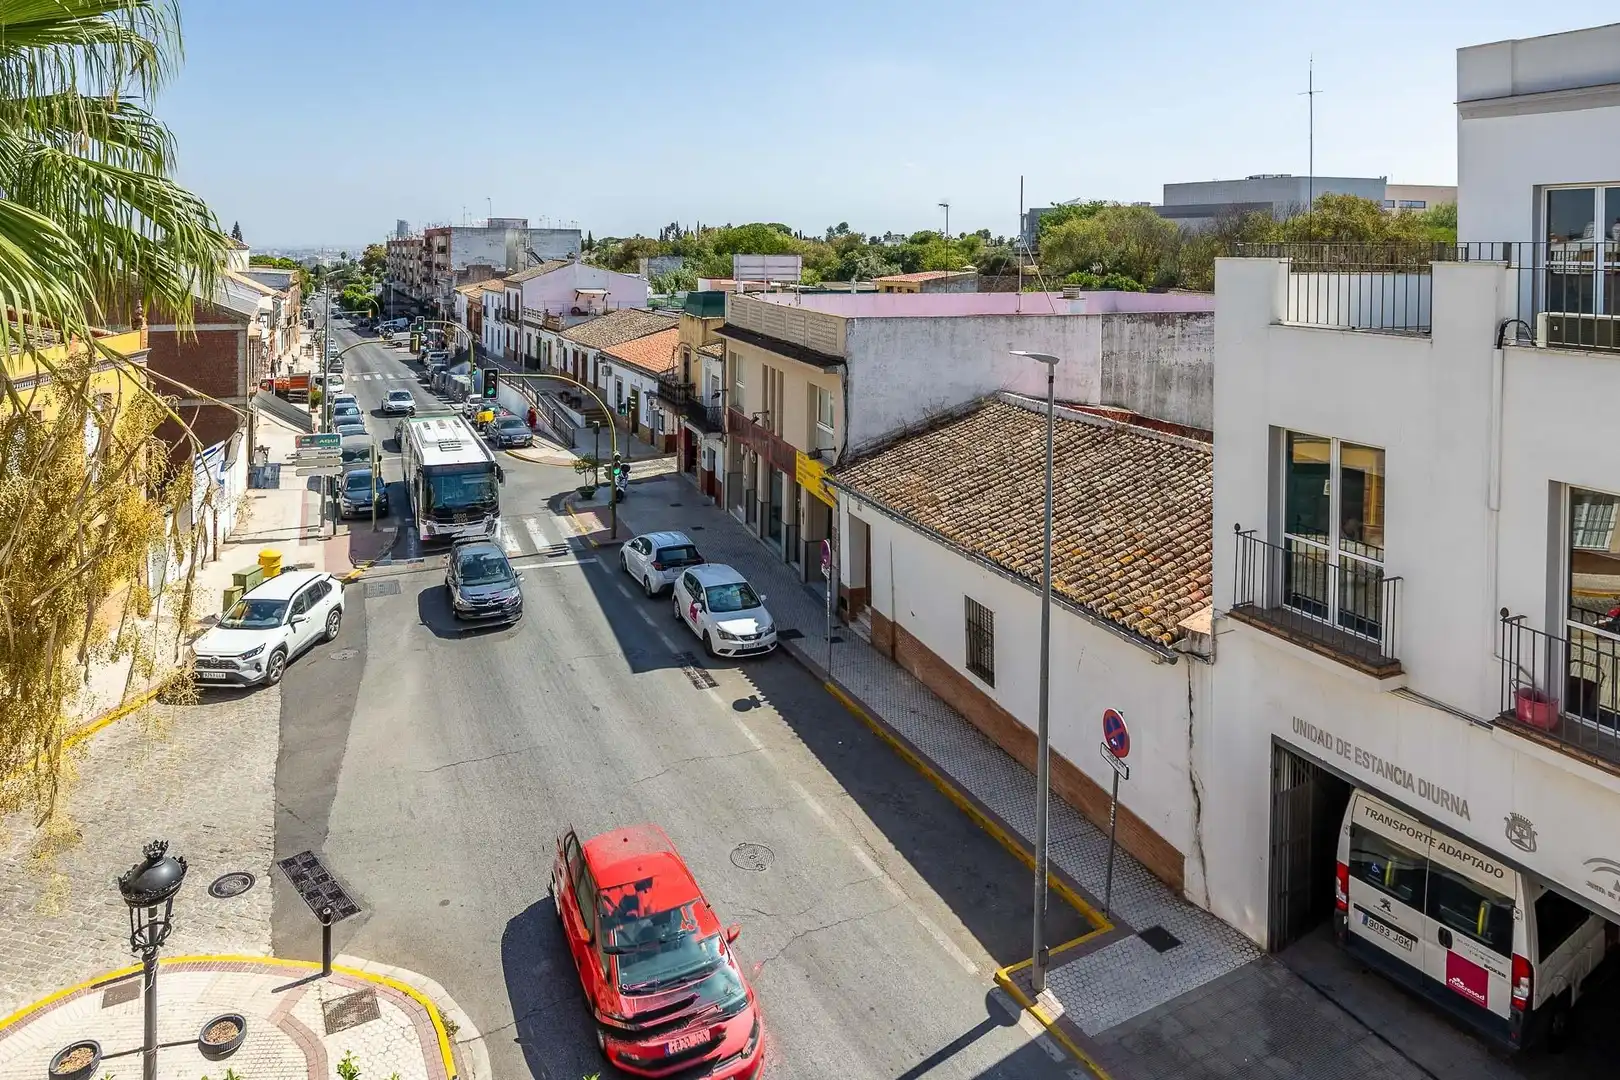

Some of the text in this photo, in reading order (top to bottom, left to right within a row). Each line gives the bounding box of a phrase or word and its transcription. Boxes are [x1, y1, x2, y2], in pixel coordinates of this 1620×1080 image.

[1292, 716, 1471, 822] UNIDAD DE ESTANCIA DIURNA
[1364, 806, 1504, 879] TRANSPORTE ADAPTADO
[1368, 919, 1410, 948] 9093 JGK
